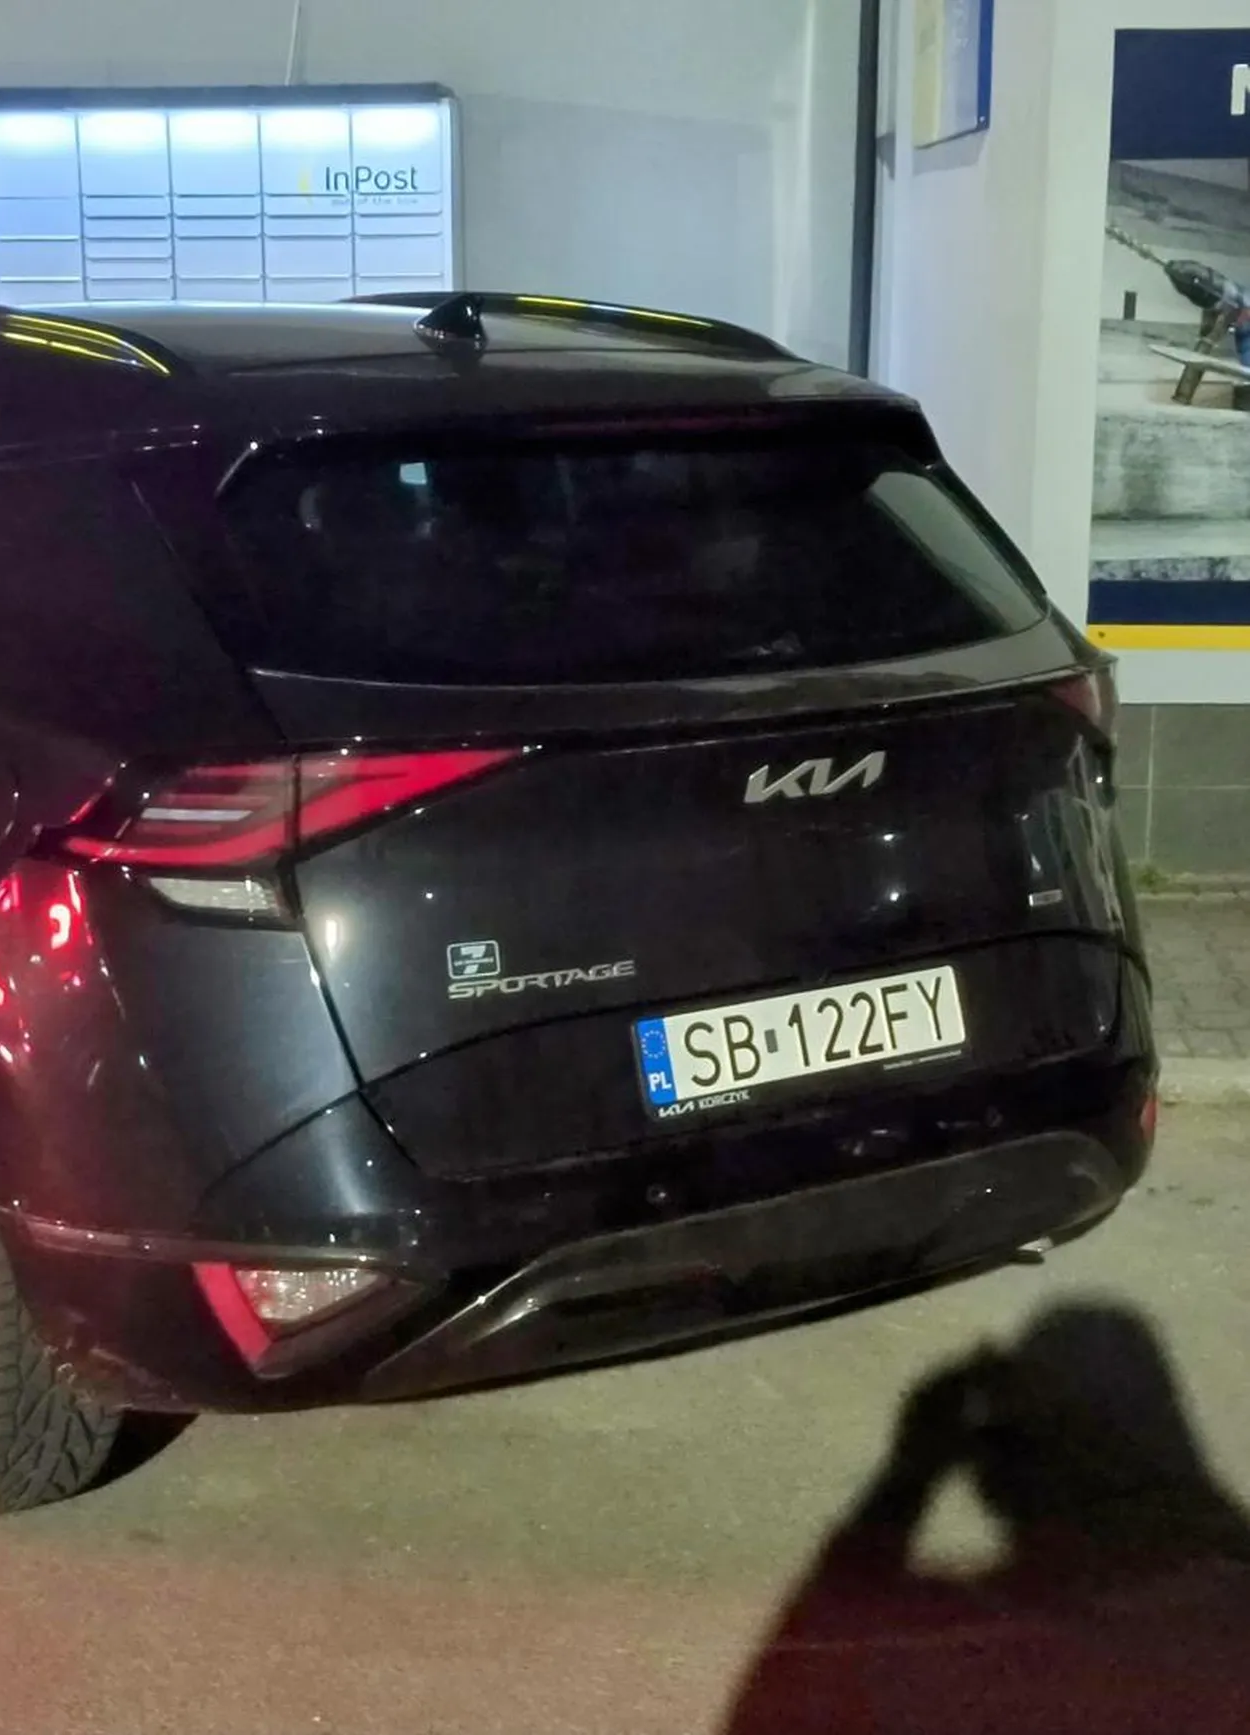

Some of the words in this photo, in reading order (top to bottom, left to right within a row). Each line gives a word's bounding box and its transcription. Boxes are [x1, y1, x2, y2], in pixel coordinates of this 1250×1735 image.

[325, 165, 419, 192] InPost
[743, 750, 886, 803] KIA
[448, 959, 636, 999] SPORTAGE
[684, 1014, 761, 1087] SB
[788, 976, 942, 1067] 122FY
[649, 1071, 672, 1092] PL
